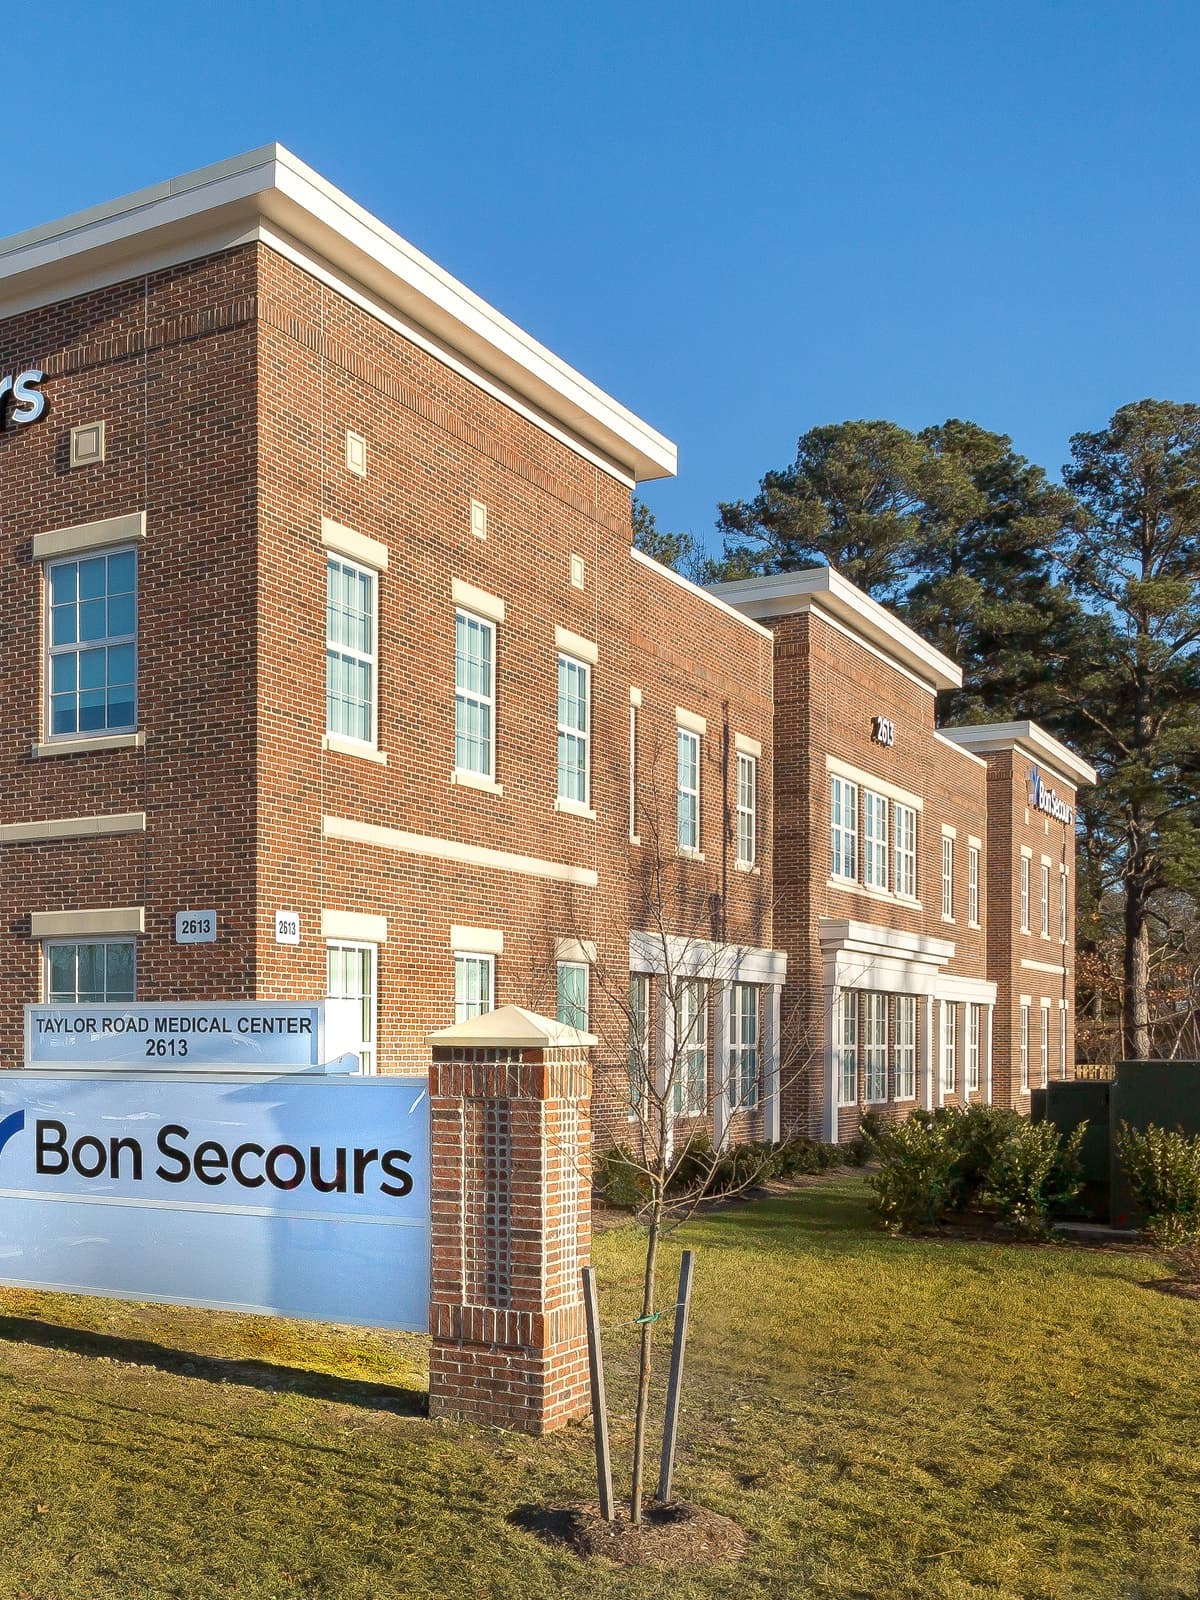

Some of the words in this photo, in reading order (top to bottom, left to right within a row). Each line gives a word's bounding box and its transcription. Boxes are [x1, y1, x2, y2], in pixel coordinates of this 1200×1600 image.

[181, 919, 211, 934] 2613
[278, 920, 296, 936] 2613
[36, 1017, 98, 1033] TAYLOR
[101, 1017, 149, 1033] ROAD
[154, 1016, 233, 1034] MEDICAL
[237, 1016, 313, 1034] CENTER
[145, 1038, 188, 1057] 2613
[35, 1119, 142, 1180] Bon
[155, 1123, 415, 1198] Secours
